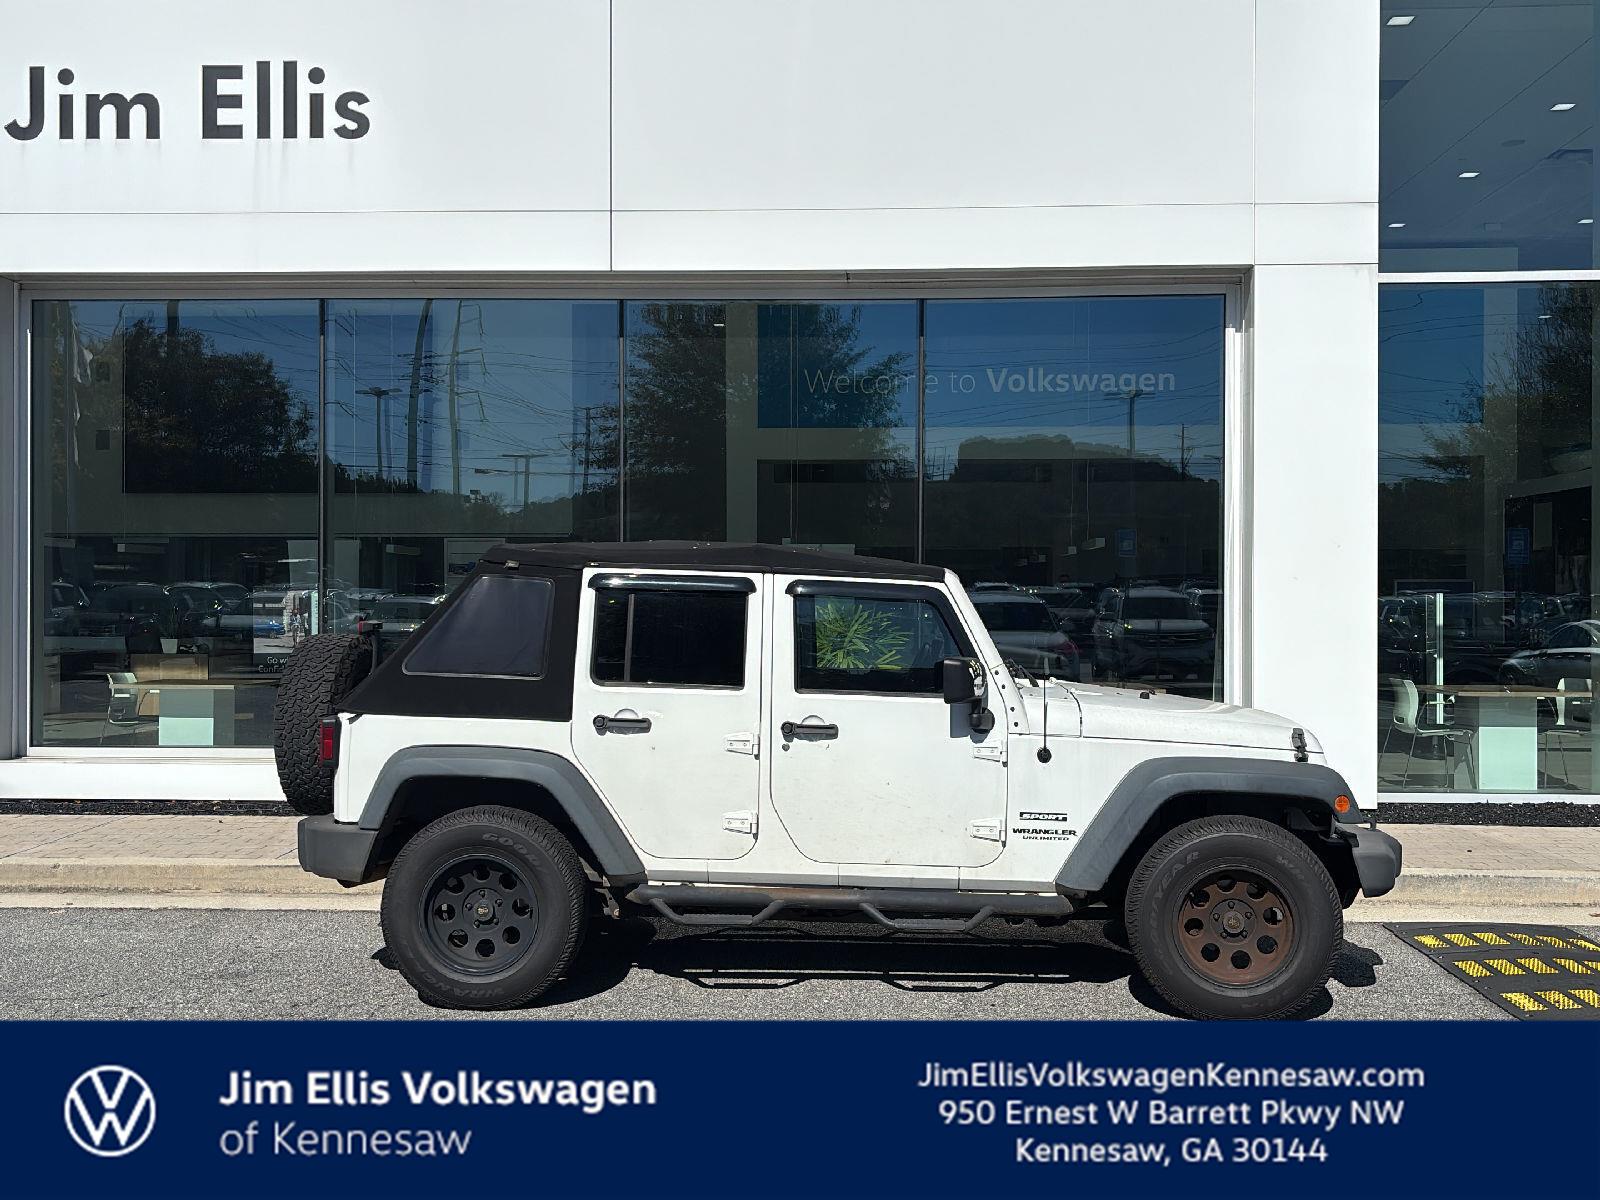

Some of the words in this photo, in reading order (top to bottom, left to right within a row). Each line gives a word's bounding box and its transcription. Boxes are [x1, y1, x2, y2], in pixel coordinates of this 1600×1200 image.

[4, 66, 160, 141] Jim
[202, 60, 370, 140] Ellis
[804, 367, 939, 394] Welcome
[949, 371, 976, 393] to
[986, 367, 1175, 397] Volkswagen
[1021, 813, 1066, 821] SPORT
[1012, 828, 1078, 836] WRANGLER
